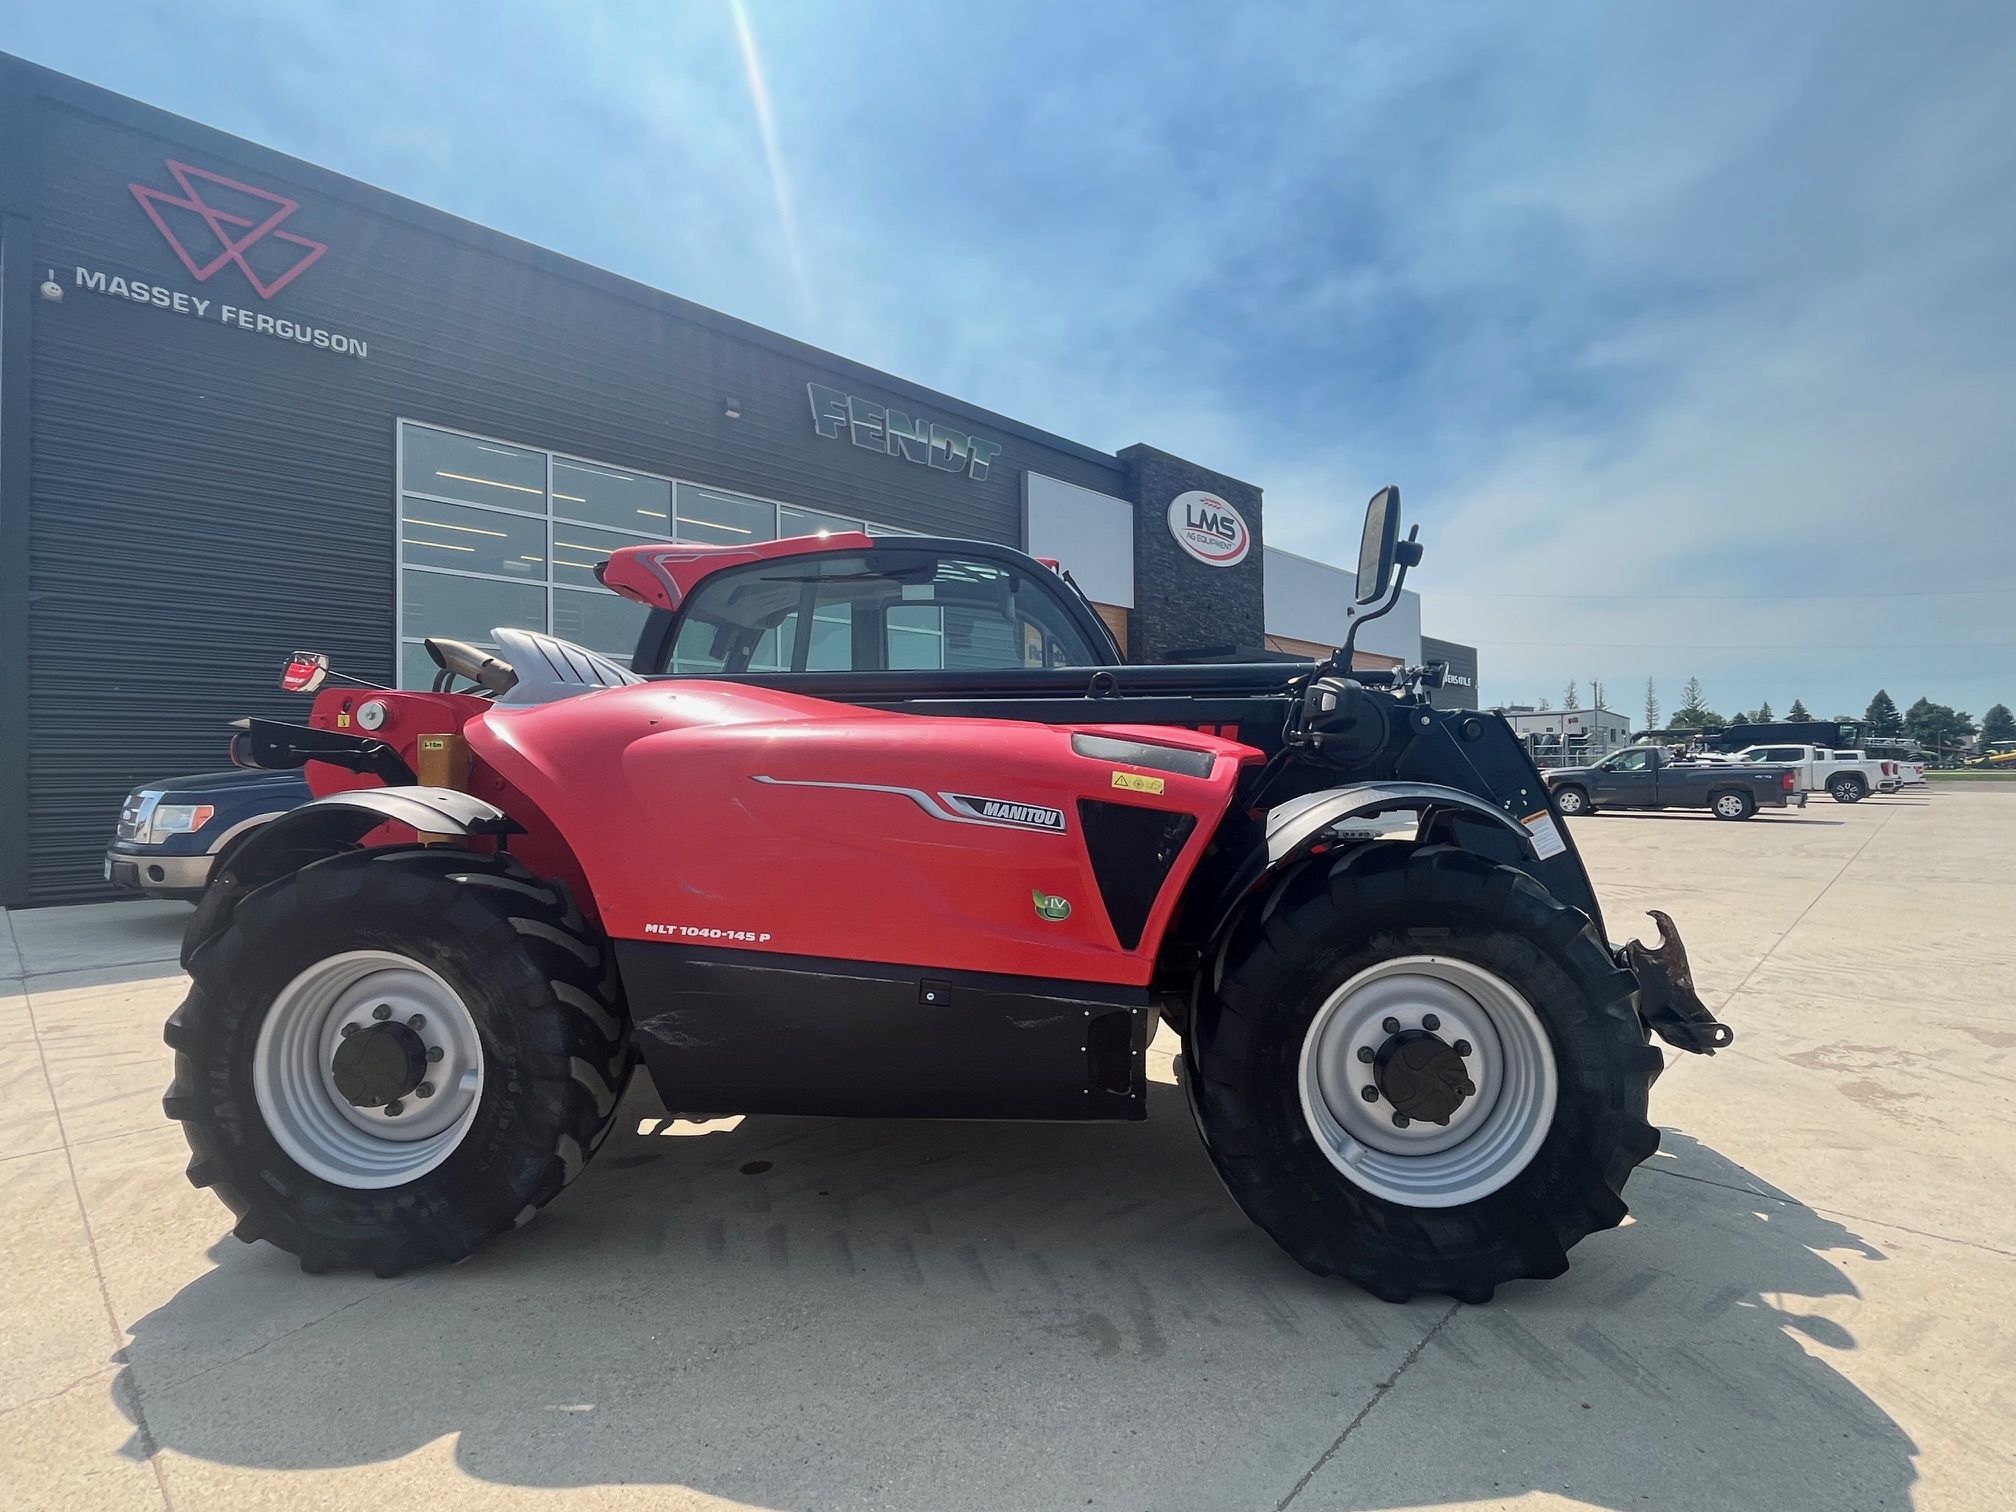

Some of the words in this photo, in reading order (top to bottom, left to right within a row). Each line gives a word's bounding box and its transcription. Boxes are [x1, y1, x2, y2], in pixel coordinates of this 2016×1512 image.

[75, 266, 211, 316] MASSEY
[221, 304, 368, 358] FERGUSON
[806, 382, 1002, 481] FENDT
[1186, 504, 1235, 540] LMS
[1186, 531, 1197, 541] AG
[1196, 534, 1232, 550] EQUIPMENT
[982, 801, 1057, 825] MANITOU
[645, 923, 677, 934] MLT
[680, 926, 756, 942] 1040-145
[759, 933, 771, 942] P
